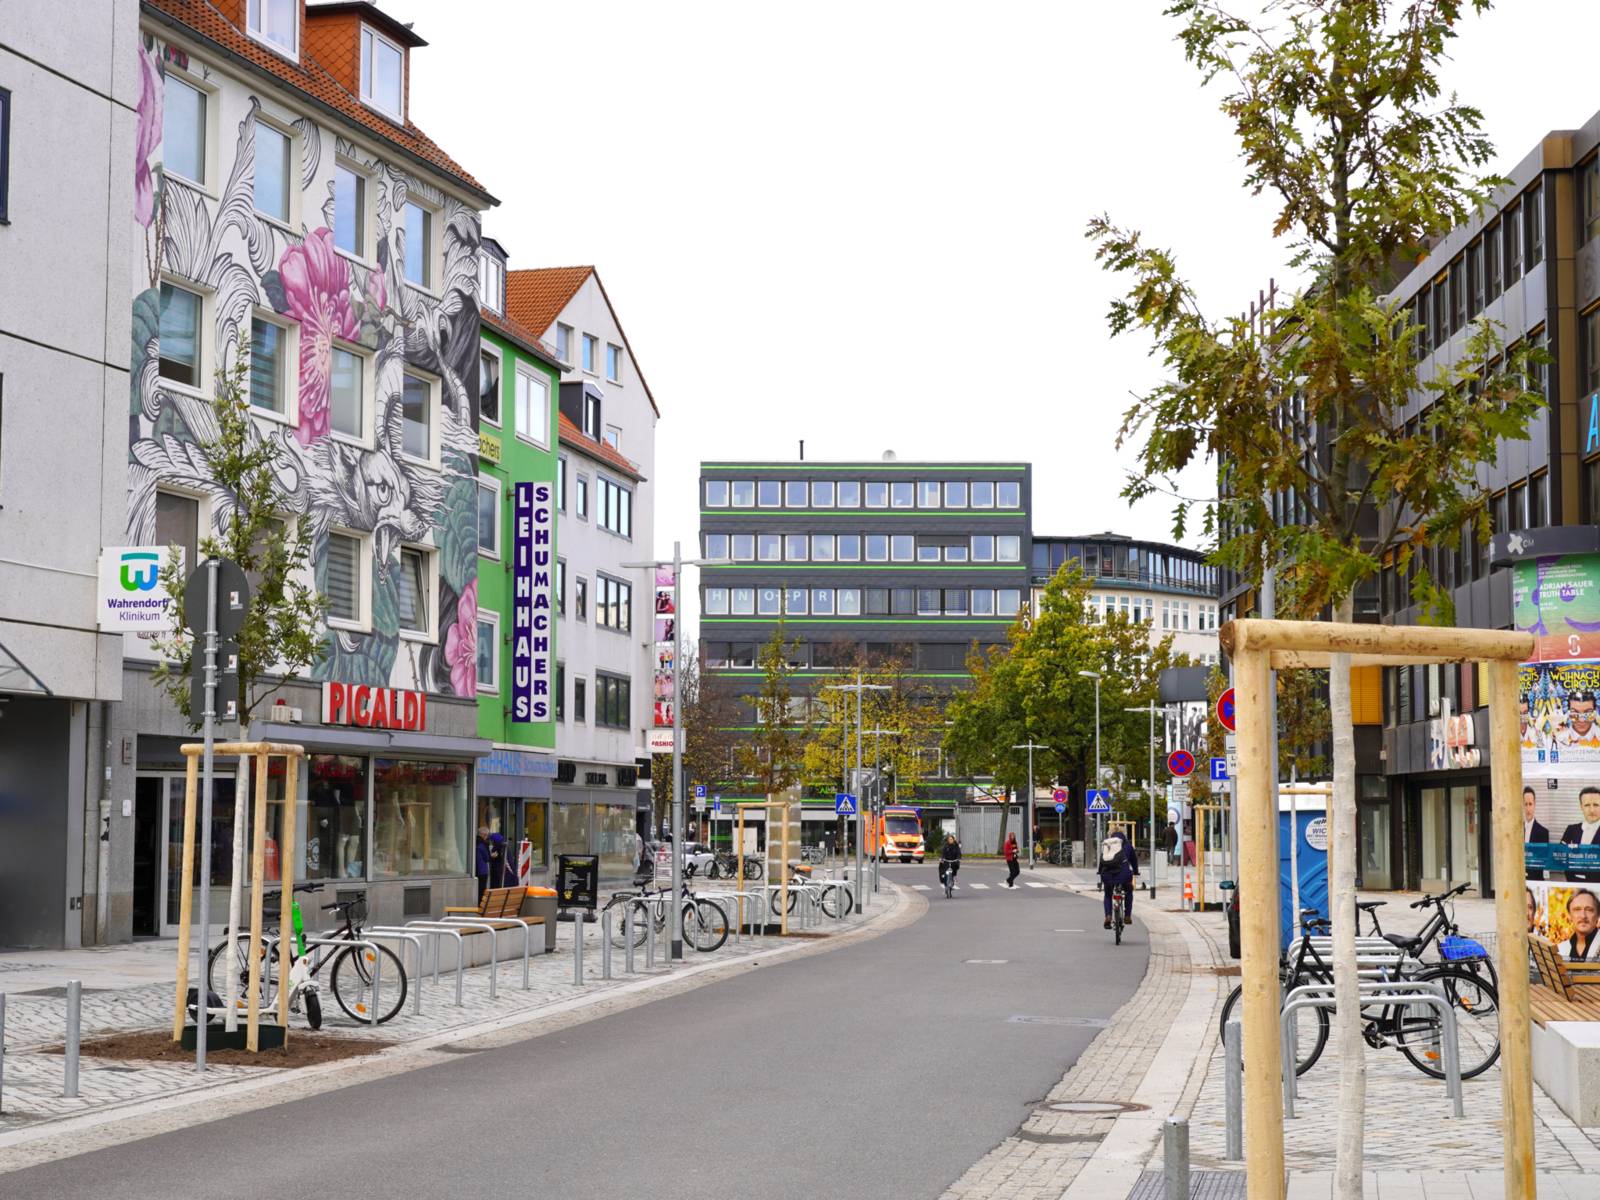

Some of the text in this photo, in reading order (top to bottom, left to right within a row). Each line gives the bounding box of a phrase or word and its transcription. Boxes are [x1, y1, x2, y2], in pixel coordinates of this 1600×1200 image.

[1540, 580, 1594, 591] ADRIAN SAUER
[1539, 588, 1585, 599] TRUTH TABLE
[515, 487, 530, 718] LEIHHAUS
[533, 486, 550, 718] SCHUMACHERS
[119, 611, 160, 621] Klinikum
[1564, 680, 1600, 689] CIRCUS
[329, 681, 427, 732] PICALDI
